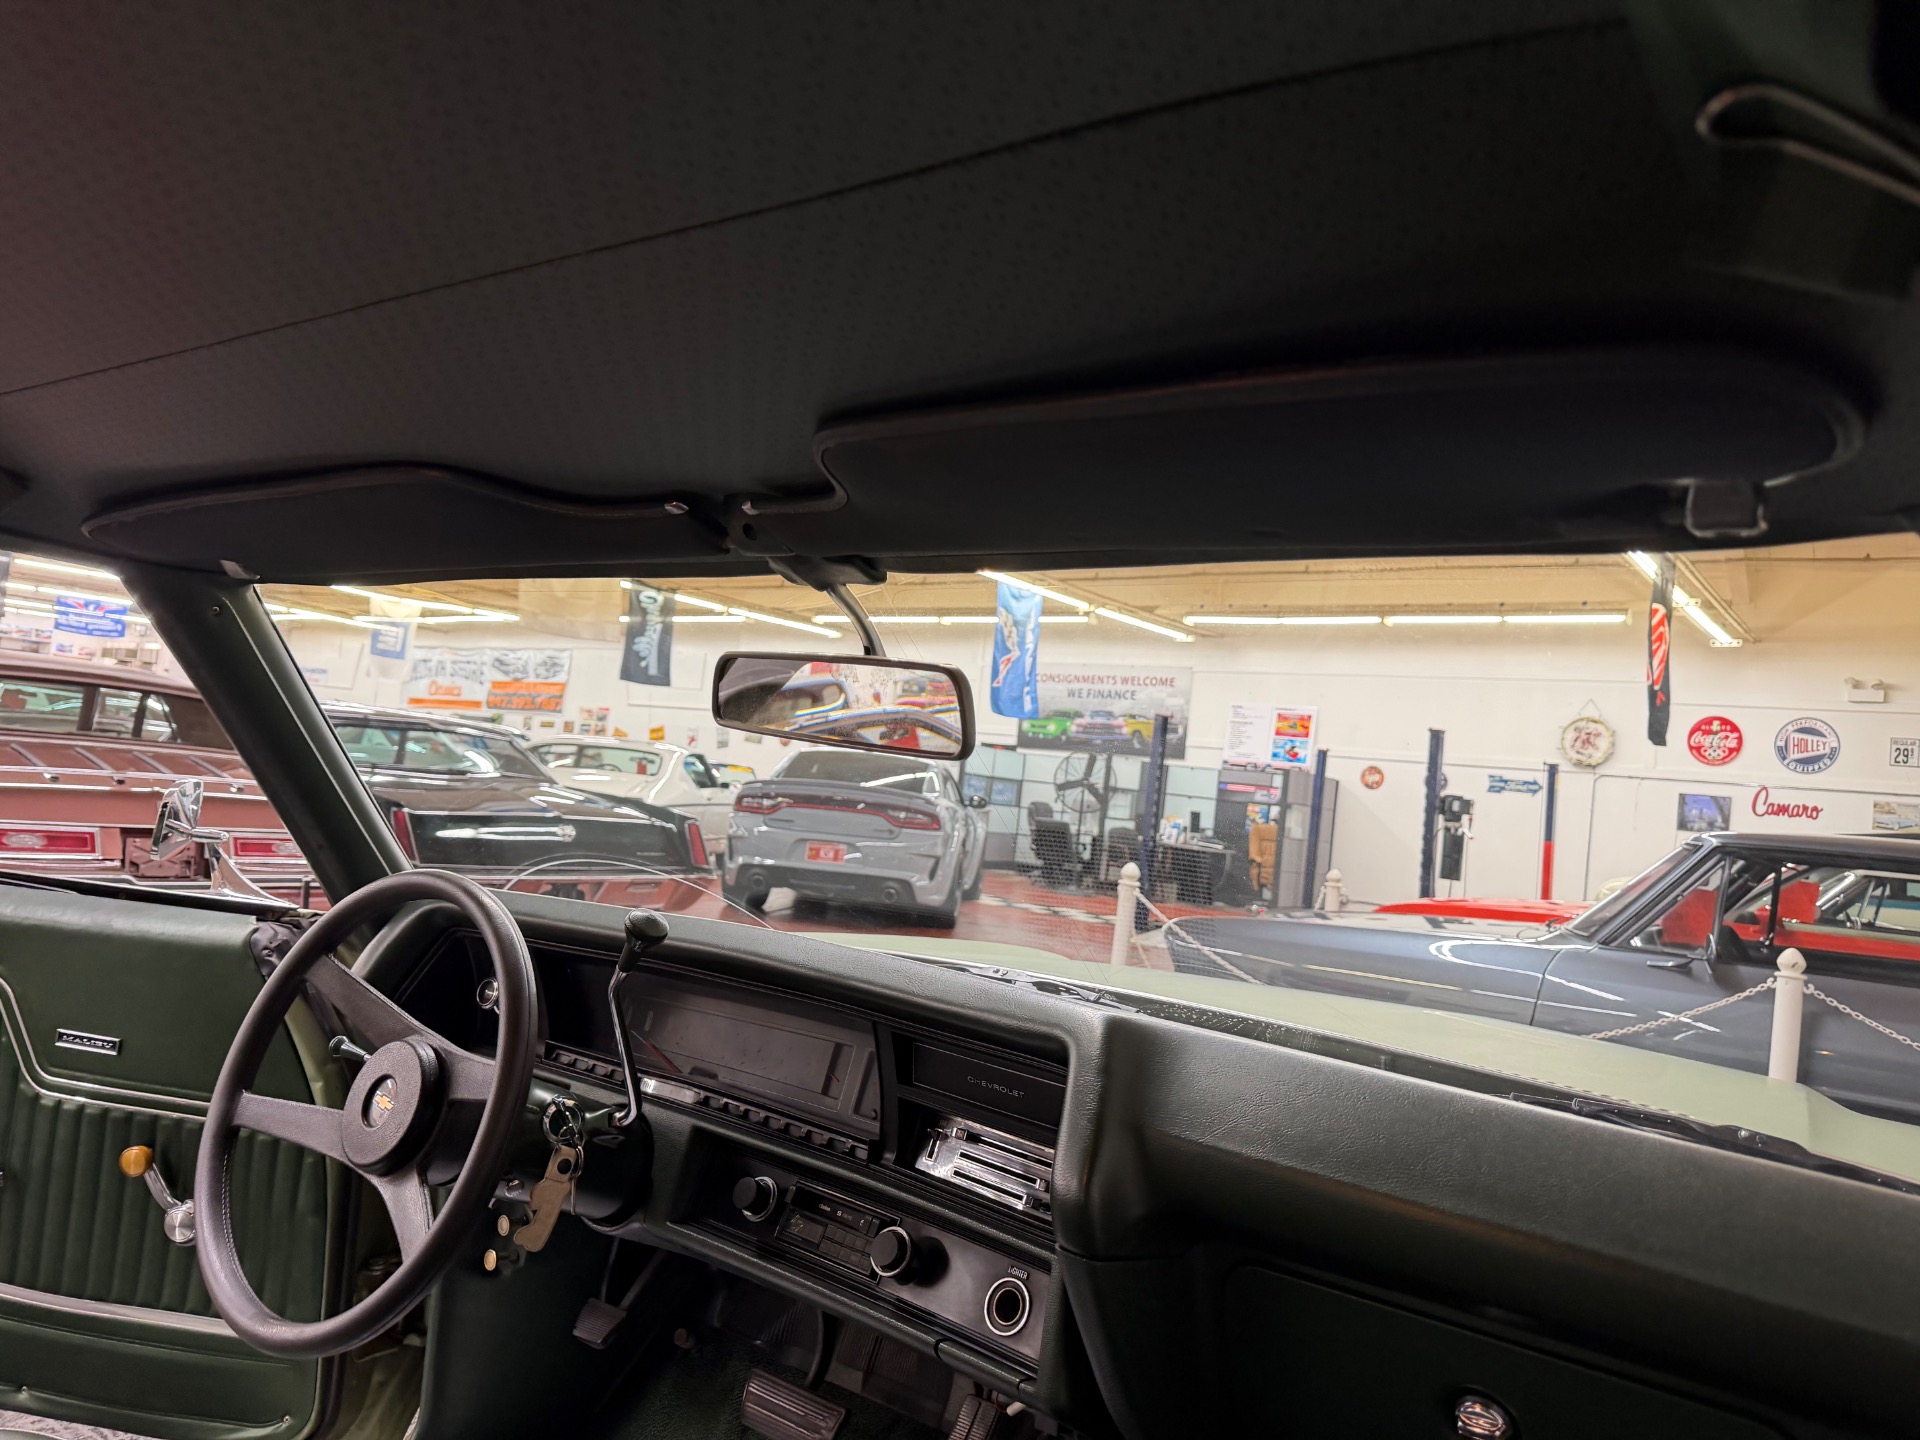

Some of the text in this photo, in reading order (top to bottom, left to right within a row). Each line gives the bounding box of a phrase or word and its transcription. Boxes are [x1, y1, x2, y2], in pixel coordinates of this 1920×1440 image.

[1036, 673, 1176, 688] CONSIGNMENTS WELCOME
[1067, 688, 1136, 701] WE FINANCE
[1793, 736, 1827, 755] HOLLEY
[1751, 785, 1823, 820] Camaro
[62, 1035, 114, 1049] MALIBU
[967, 1075, 1025, 1098] CHEVROLET
[1008, 1265, 1028, 1280] LIGHTER
